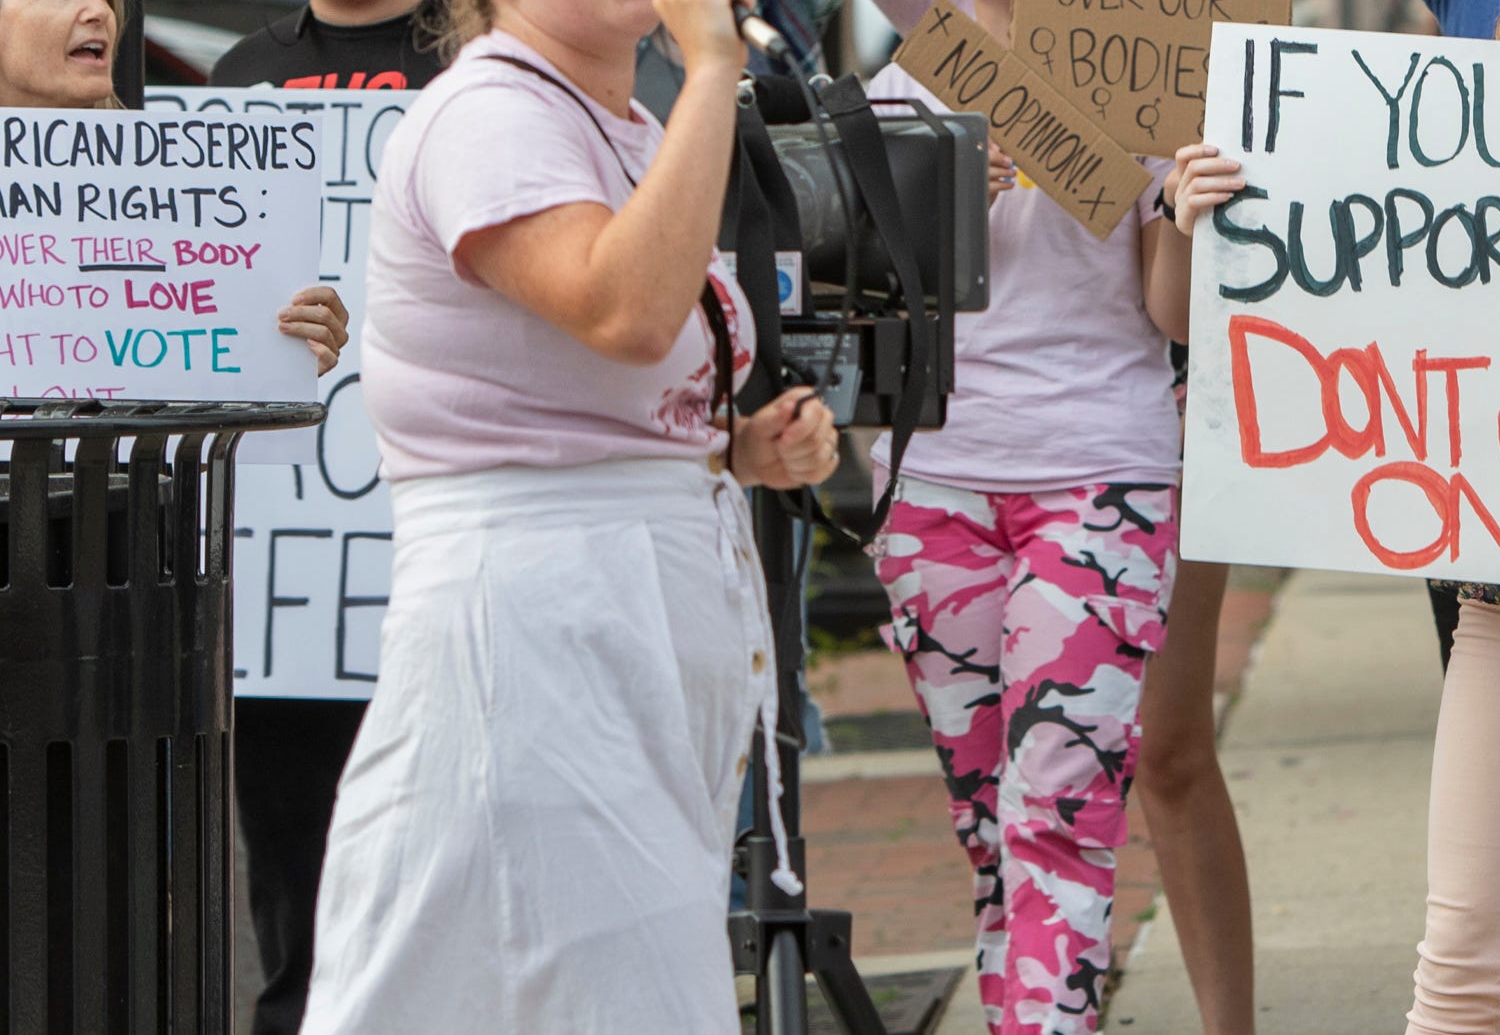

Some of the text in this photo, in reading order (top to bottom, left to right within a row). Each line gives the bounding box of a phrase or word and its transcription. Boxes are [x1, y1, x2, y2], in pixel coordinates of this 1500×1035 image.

[934, 38, 997, 105] NO
[1243, 38, 1317, 152] IF
[135, 119, 316, 170] DESERVES
[0, 182, 268, 228] AN RIGHTS:
[71, 237, 167, 265] THEIR
[172, 240, 261, 269] BODY
[67, 284, 109, 309] TO
[124, 279, 218, 315] LOVE
[50, 334, 98, 365] TO
[105, 328, 241, 373] VOTE
[1229, 314, 1491, 468] DONT
